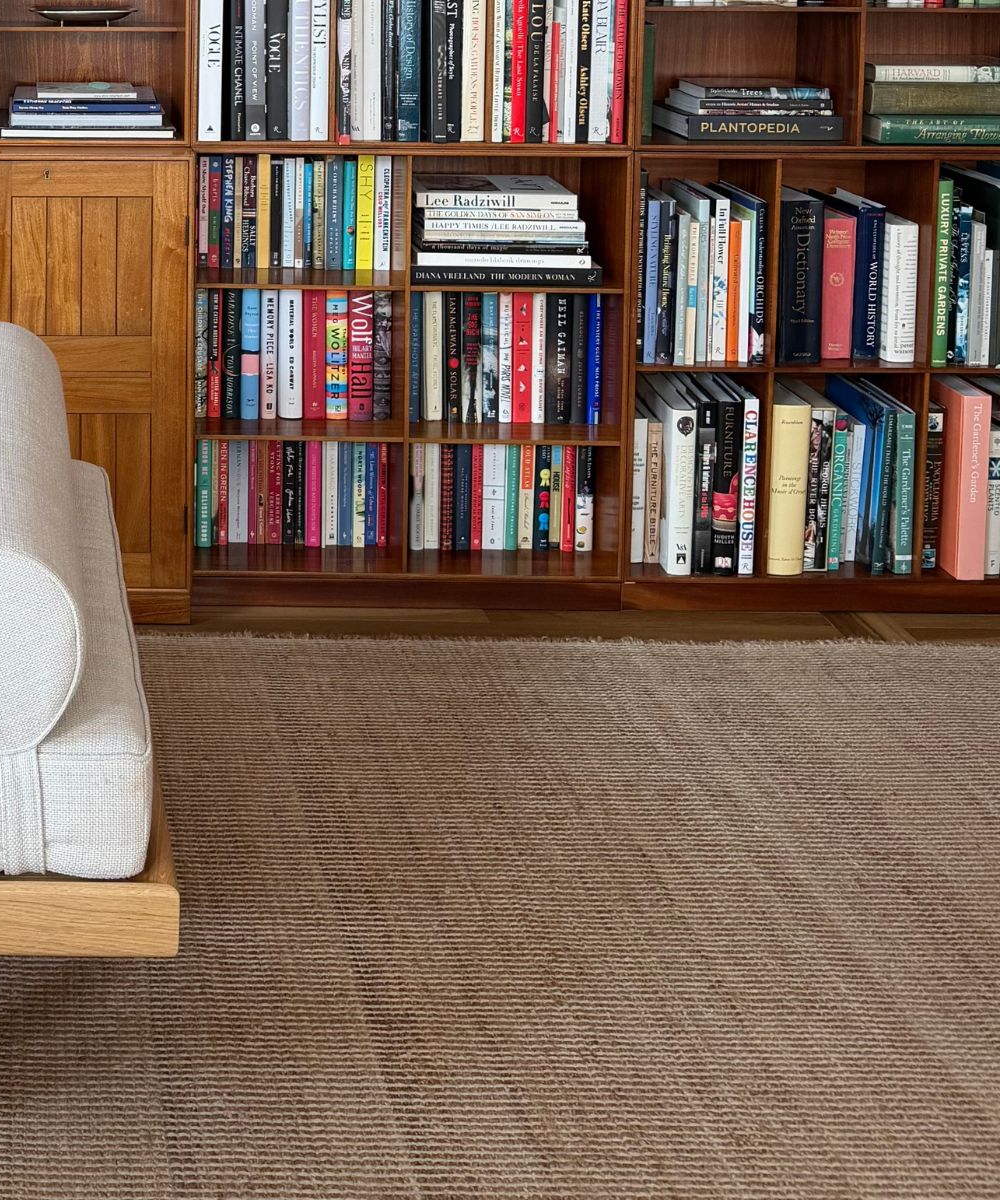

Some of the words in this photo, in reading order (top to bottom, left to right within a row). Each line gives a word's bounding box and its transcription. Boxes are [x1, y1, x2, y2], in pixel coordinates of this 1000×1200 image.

[207, 24, 221, 68] VOGUE
[268, 33, 280, 73] VOGUE
[581, 24, 590, 51] Olsen
[595, 17, 608, 54] BLAIR
[578, 65, 589, 97] Ashley
[578, 98, 588, 125] Olsen
[700, 122, 800, 134] PLANTOPEDIA
[223, 158, 233, 196] STEPHEN
[360, 163, 373, 201] SHY
[223, 198, 233, 223] KING
[425, 194, 448, 207] Lee
[453, 194, 516, 207] Radziwill
[940, 193, 950, 234] LUXURY
[415, 272, 441, 280] DIANA
[442, 272, 486, 280] VREELAND
[490, 272, 505, 280] THE
[508, 272, 543, 280] MODERN
[545, 272, 576, 281] WOMAN
[791, 232, 812, 314] Dictionary
[937, 238, 949, 282] PRIVATE
[755, 275, 765, 324] ORCHIDS
[868, 262, 879, 301] WORLD
[350, 293, 373, 345] Wolf
[557, 298, 567, 327] NEIL
[866, 303, 877, 348] HISTORY
[936, 285, 947, 337] GARDENS
[331, 328, 341, 400] WOLITZER
[557, 332, 566, 375] GAIMAN
[350, 361, 372, 400] Hall
[973, 403, 983, 422] The
[723, 406, 735, 477] FURNITURE
[743, 410, 759, 497] CLARENCE
[901, 448, 911, 464] The
[971, 423, 981, 471] Gardener's
[831, 444, 846, 507] ORGANIC
[900, 466, 911, 515] Gardener's
[970, 472, 980, 503] Garden
[741, 498, 757, 552] HOUSE
[900, 517, 909, 546] Palette
